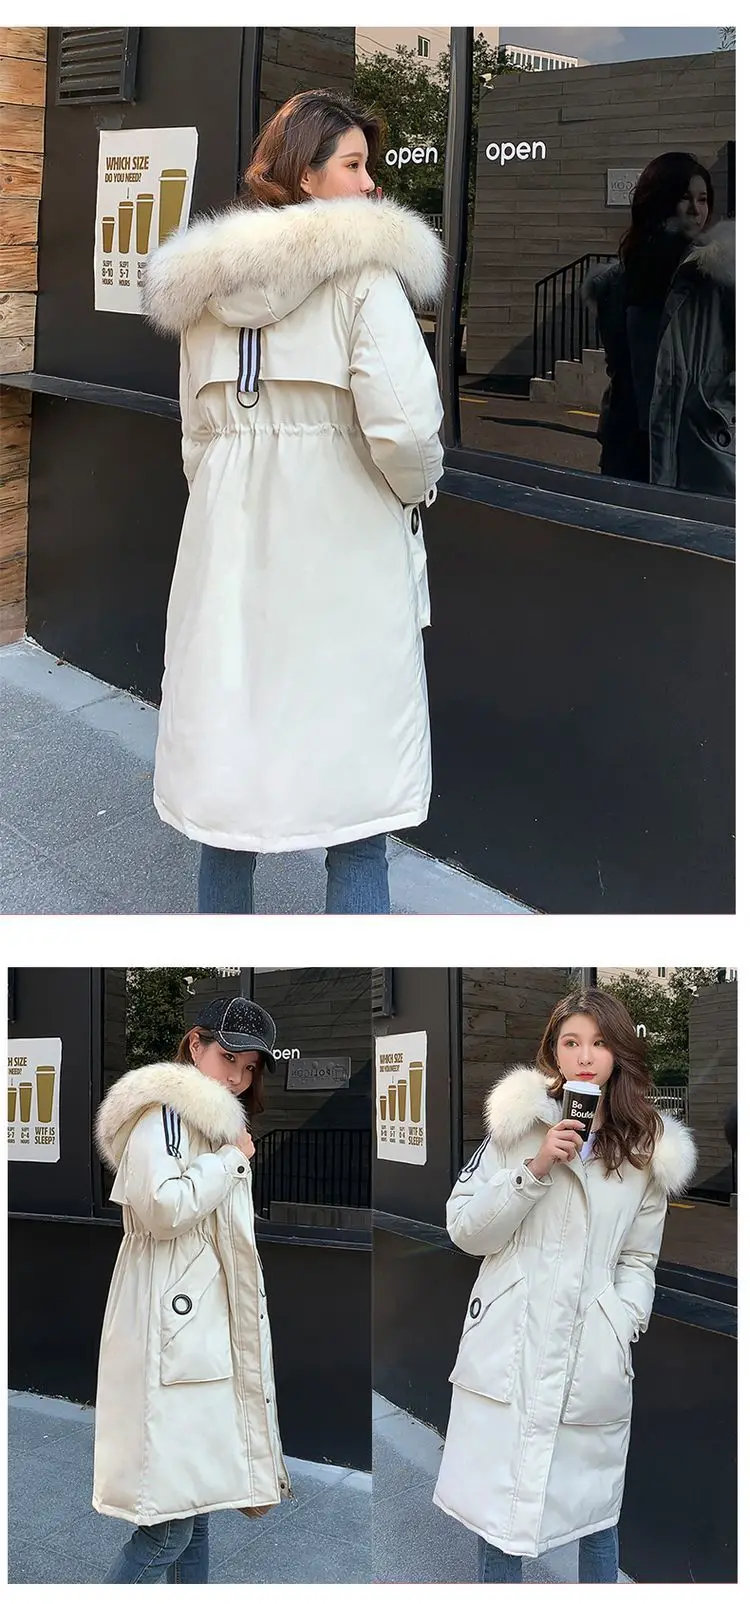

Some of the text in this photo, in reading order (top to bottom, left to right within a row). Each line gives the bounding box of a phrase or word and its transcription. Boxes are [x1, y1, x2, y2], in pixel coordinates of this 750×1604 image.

[385, 146, 438, 169] open
[485, 140, 546, 166] open
[105, 156, 150, 171] WHICH SIZE
[104, 172, 142, 183] DO YOU NEED?
[273, 1048, 300, 1060] pen
[14, 1056, 27, 1067] SIZE
[34, 1126, 55, 1136] WTF IS
[34, 1135, 55, 1145] SLEEP?
